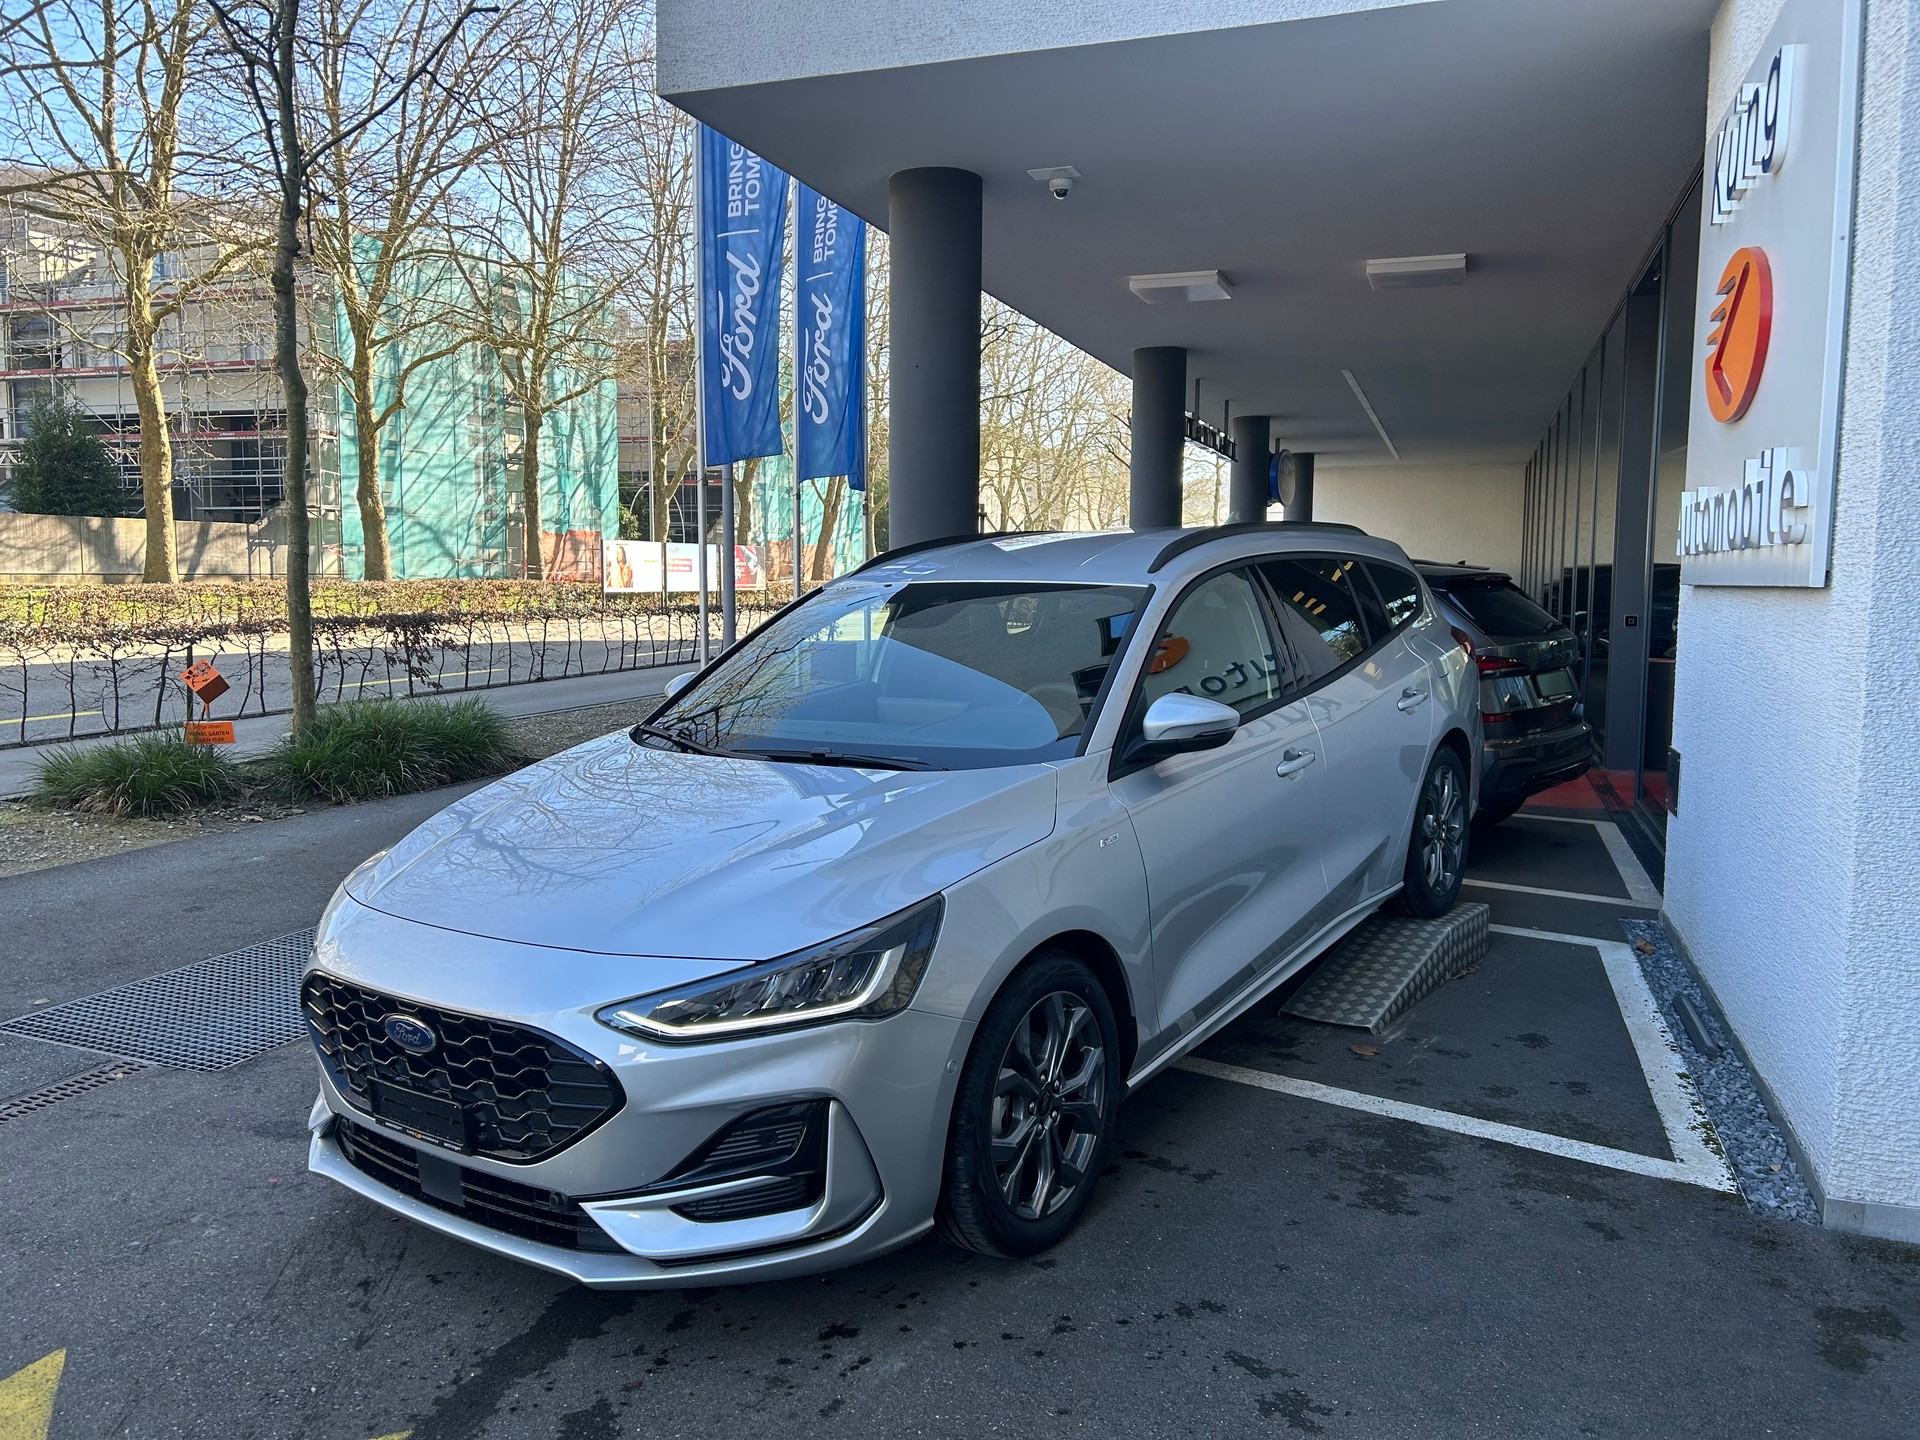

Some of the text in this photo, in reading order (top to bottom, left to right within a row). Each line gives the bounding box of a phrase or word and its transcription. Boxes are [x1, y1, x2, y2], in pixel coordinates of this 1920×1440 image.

[728, 143, 744, 217] BRING
[813, 196, 827, 263] BRING
[717, 251, 761, 400] Ford
[804, 293, 833, 424] Ford
[1676, 447, 1808, 555] utomobile
[394, 1022, 421, 1045] Ford
